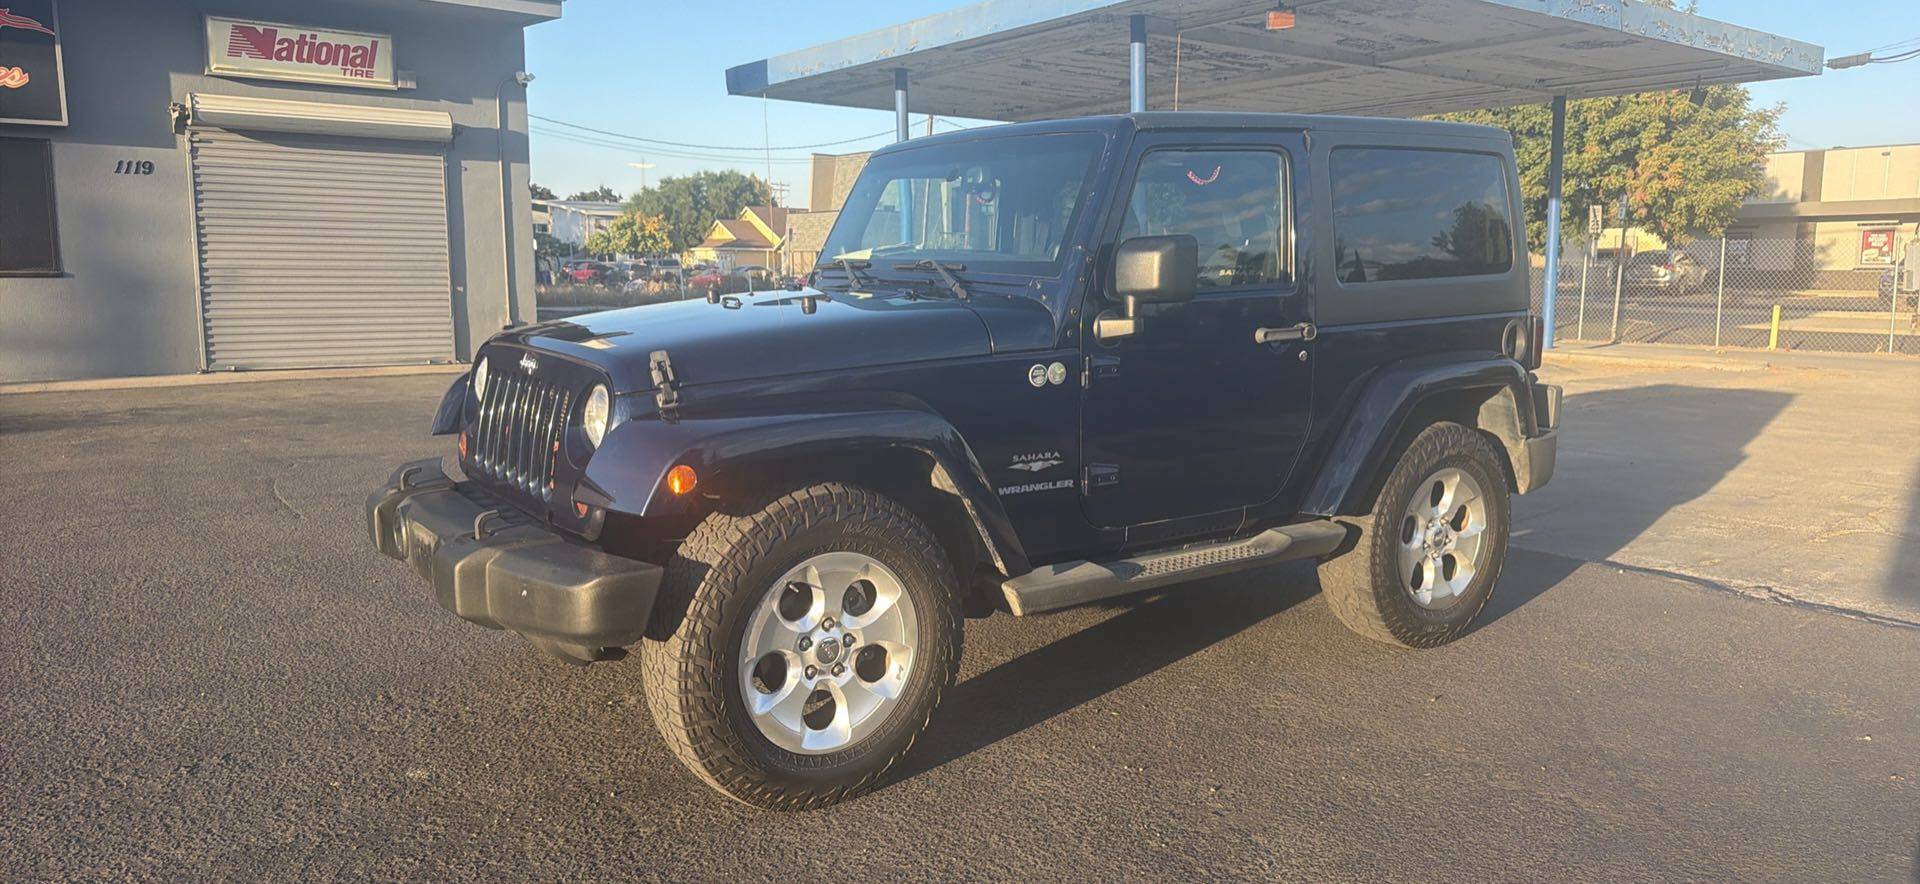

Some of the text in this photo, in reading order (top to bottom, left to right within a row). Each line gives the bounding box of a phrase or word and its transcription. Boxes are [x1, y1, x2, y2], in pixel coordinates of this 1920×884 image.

[227, 24, 378, 69] National
[340, 67, 375, 79] TIRE
[114, 160, 155, 175] 1119
[1012, 451, 1060, 462] SAHARA
[998, 479, 1074, 495] WRANGLER
